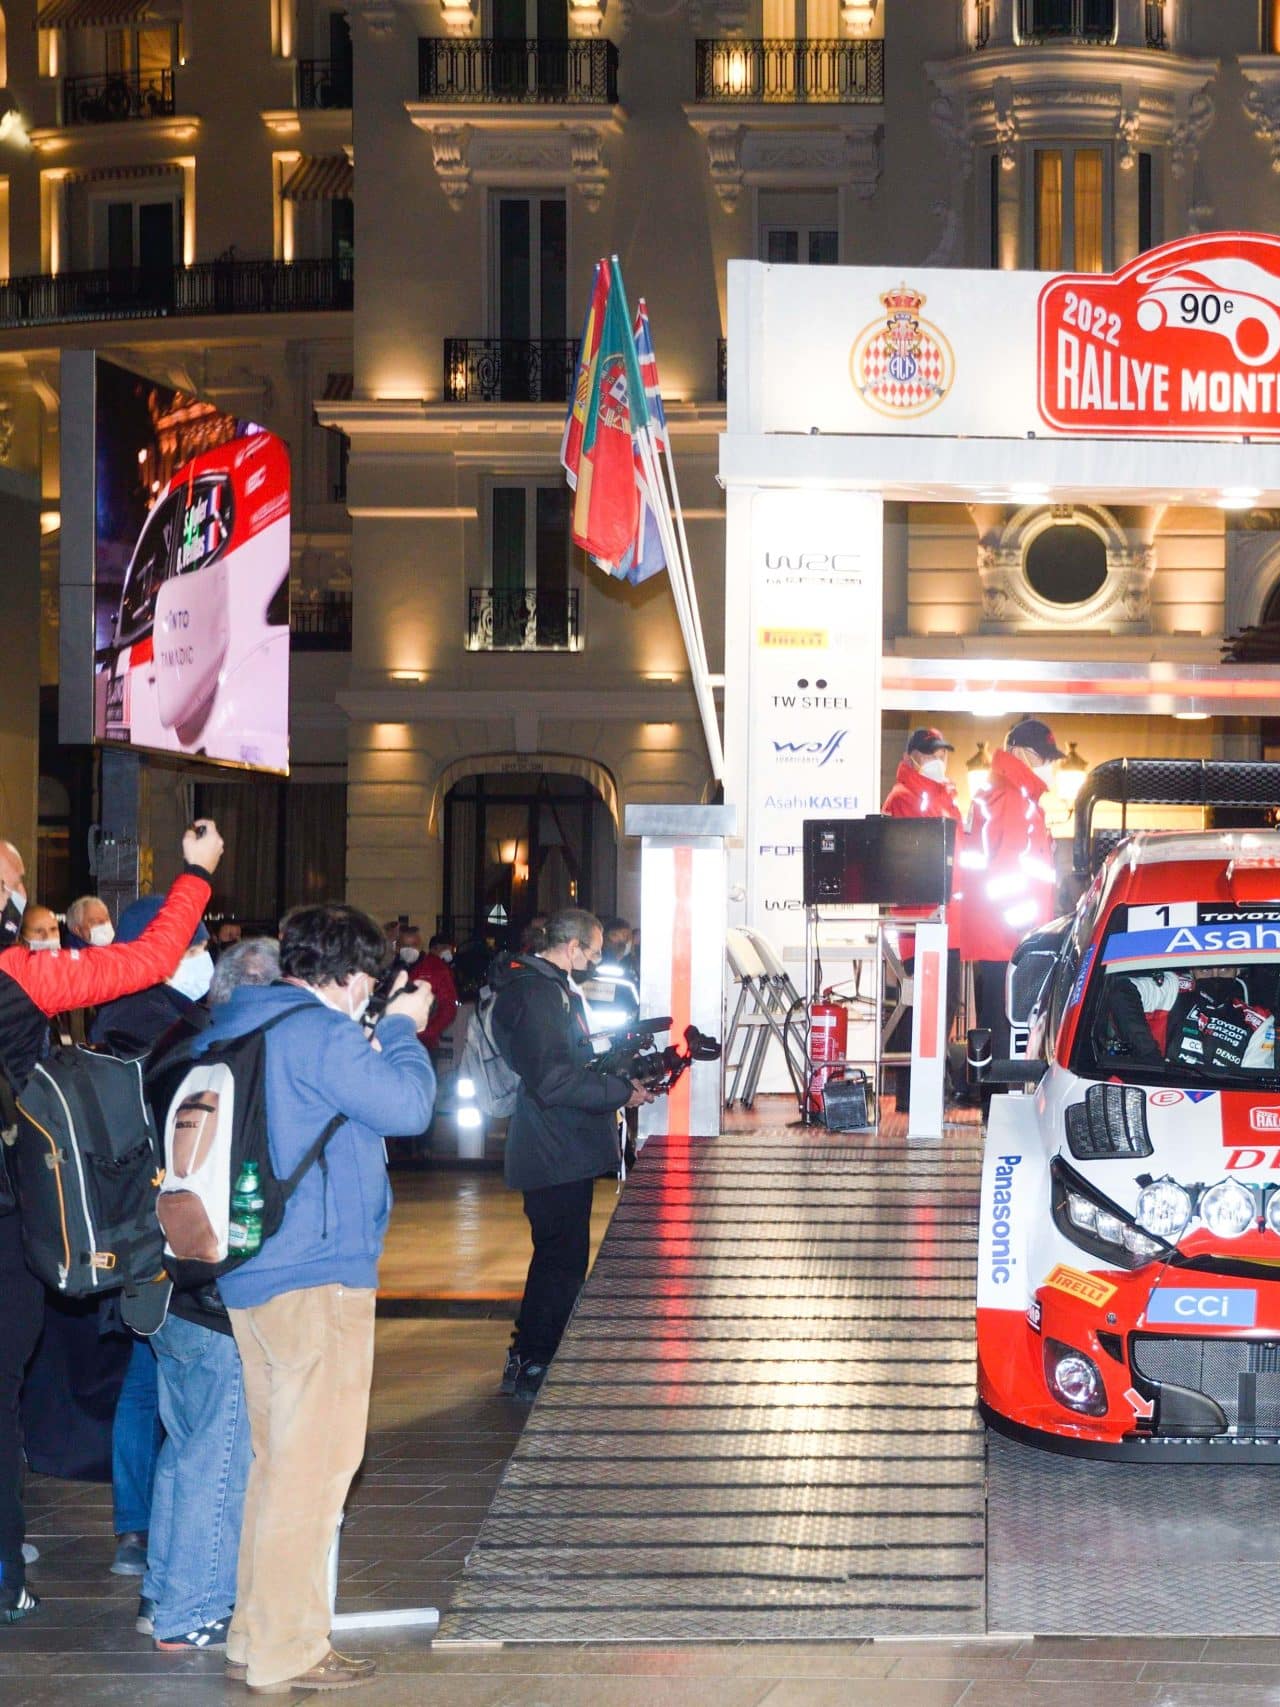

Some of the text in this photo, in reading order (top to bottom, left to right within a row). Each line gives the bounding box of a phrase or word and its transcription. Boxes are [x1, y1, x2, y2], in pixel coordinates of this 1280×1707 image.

[1062, 290, 1122, 348] 2022
[1057, 329, 1169, 411] RALLYE
[1155, 905, 1170, 927] 1
[991, 1155, 1022, 1285] Panasonic
[1052, 1270, 1110, 1302] PIRELLI
